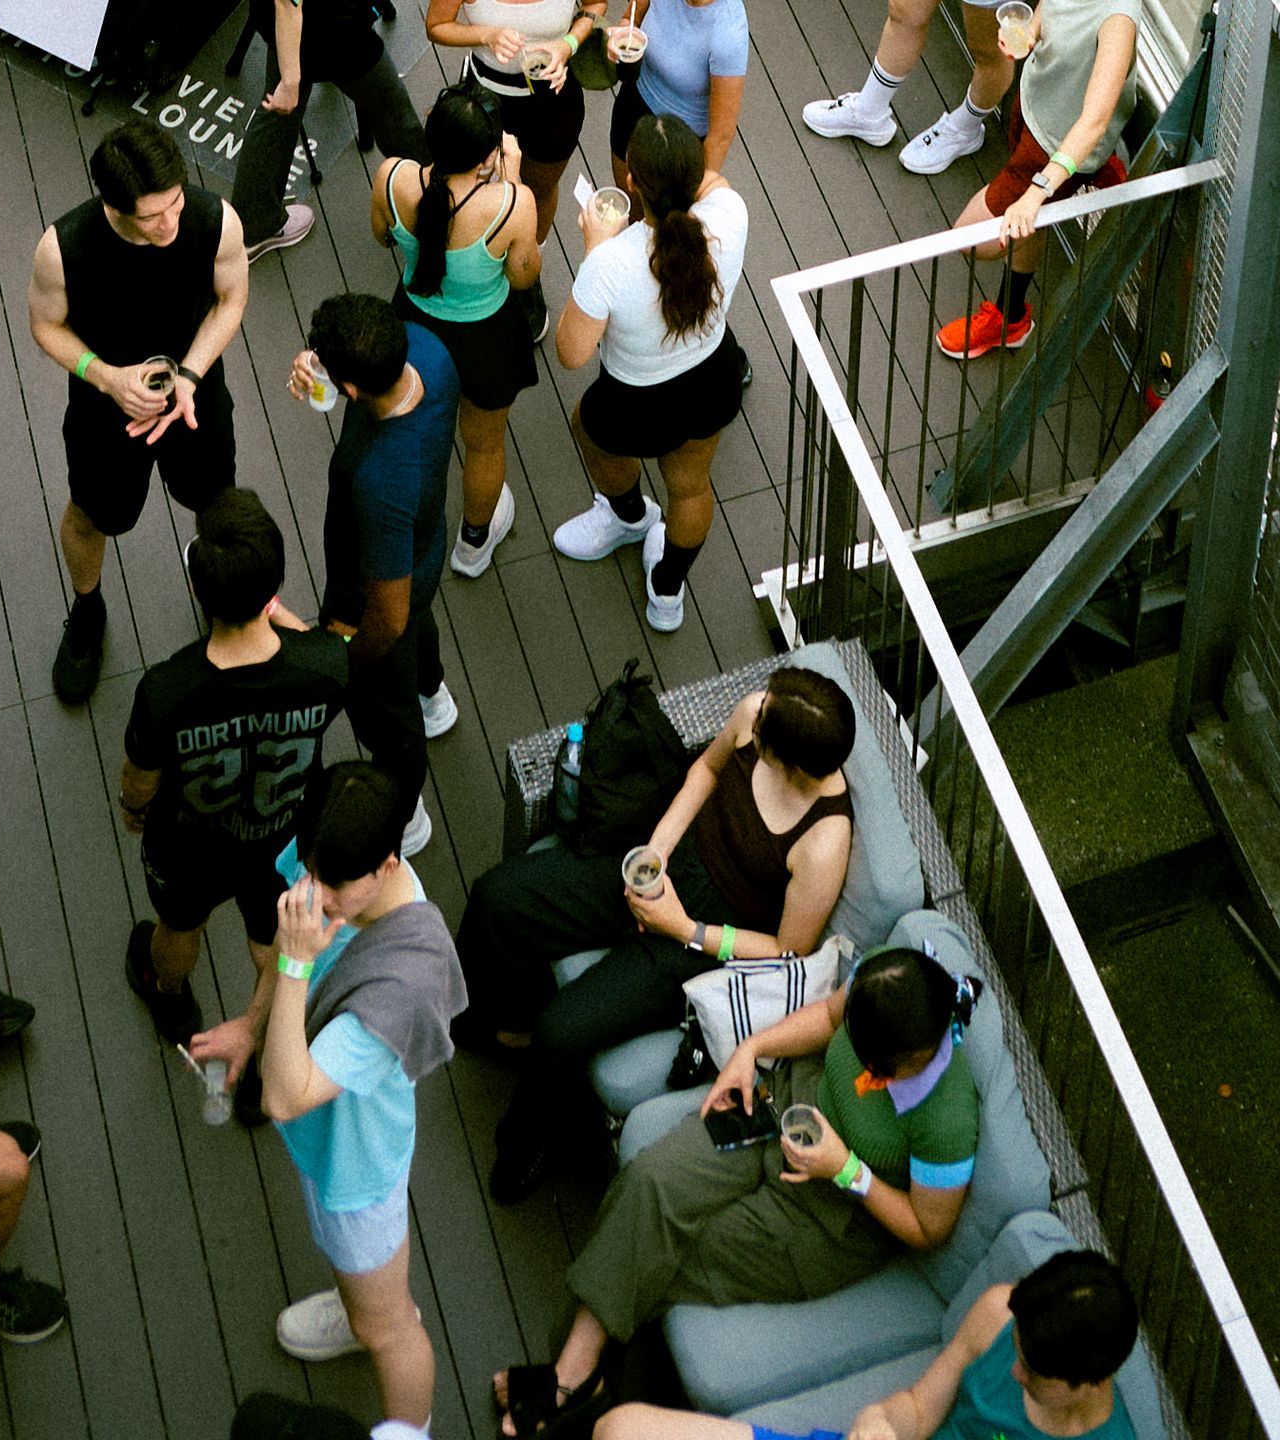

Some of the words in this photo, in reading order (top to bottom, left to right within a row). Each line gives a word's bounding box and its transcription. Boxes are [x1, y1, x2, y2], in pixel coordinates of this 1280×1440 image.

[177, 73, 257, 131] VIE
[176, 703, 328, 754] DORTMUND
[179, 736, 317, 817] 22
